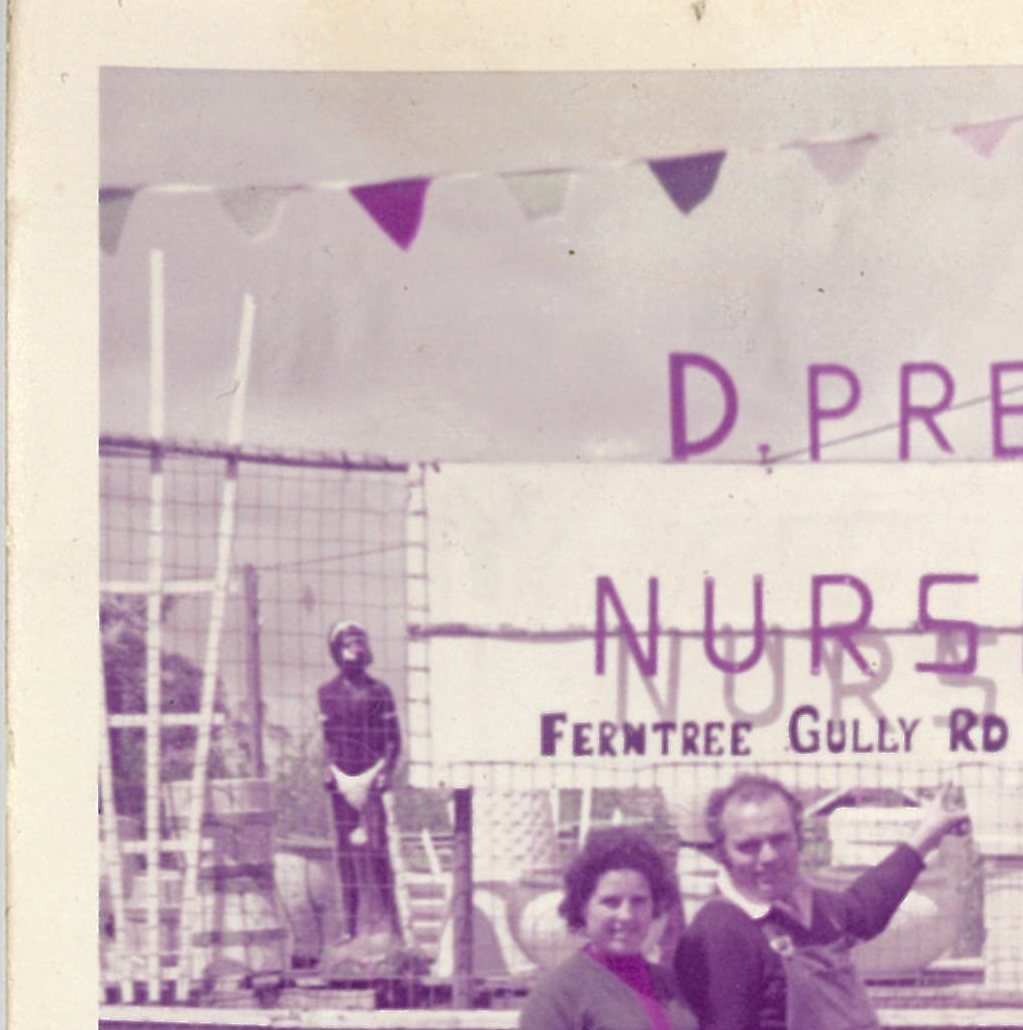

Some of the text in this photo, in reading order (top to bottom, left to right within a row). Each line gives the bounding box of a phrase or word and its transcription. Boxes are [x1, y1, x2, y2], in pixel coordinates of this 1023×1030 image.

[540, 713, 752, 756] FERNTREE
[789, 705, 920, 753] GULLY
[950, 708, 1008, 752] RD
